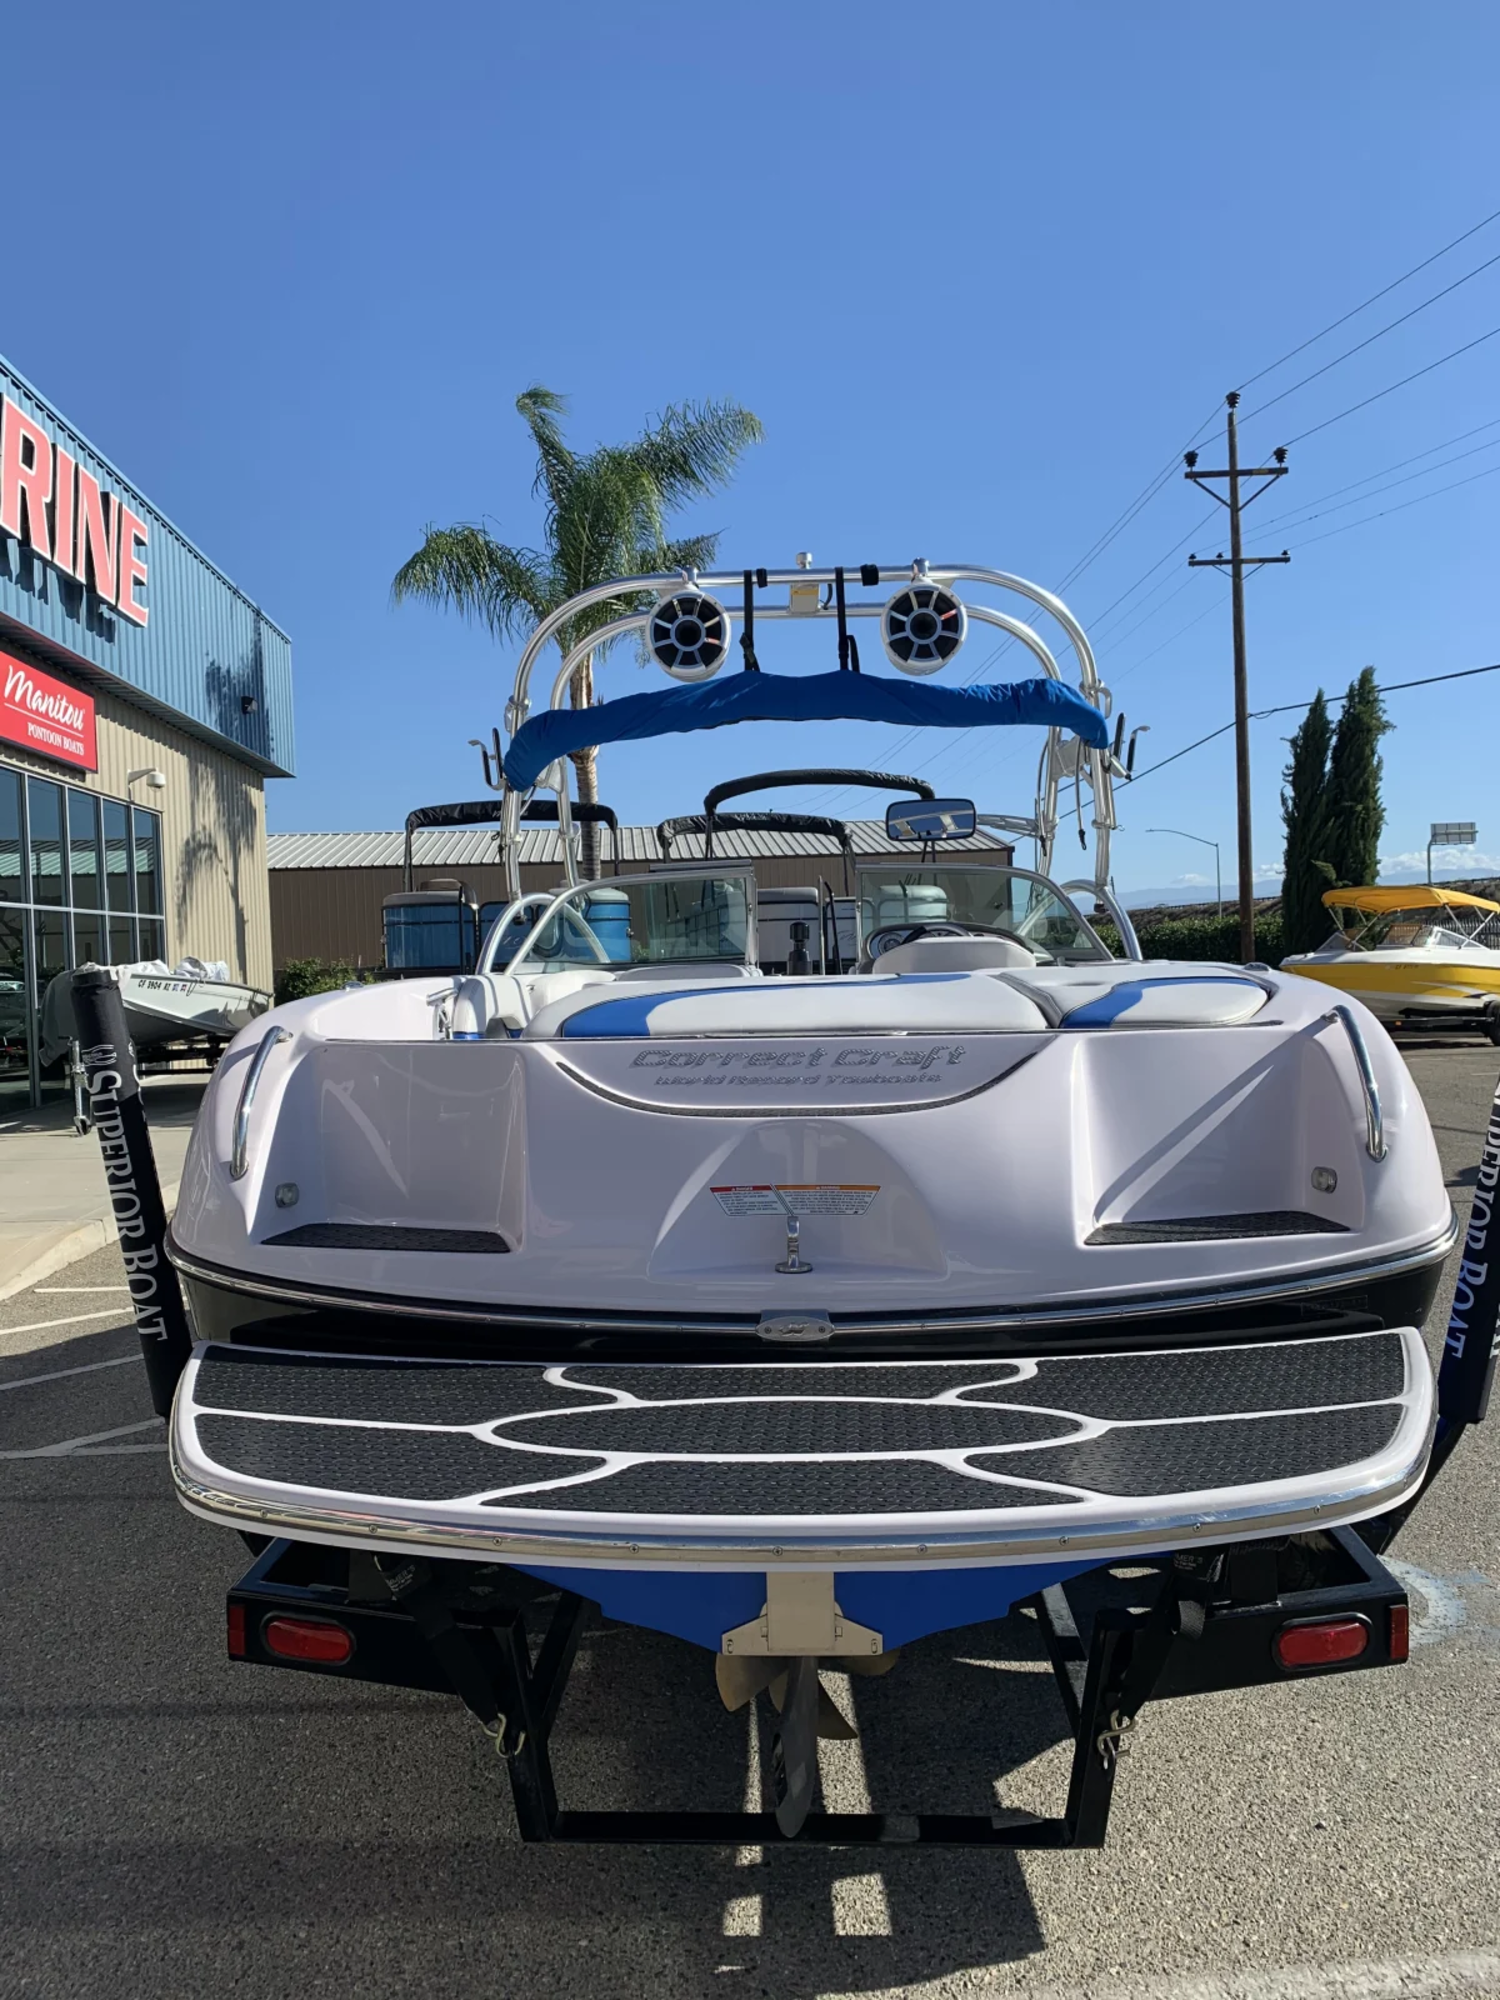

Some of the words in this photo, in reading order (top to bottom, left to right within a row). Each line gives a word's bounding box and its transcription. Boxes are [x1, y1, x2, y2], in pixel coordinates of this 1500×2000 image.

[0, 392, 149, 628] RINE
[4, 665, 84, 731] Manitou
[27, 722, 62, 747] PONTOON
[63, 735, 84, 756] BOATS
[630, 1047, 827, 1068] Correct
[834, 1045, 966, 1070] Craft
[84, 1070, 145, 1245] SUPERIOR
[121, 1243, 168, 1342] BOAT
[1446, 1258, 1488, 1358] BOAT
